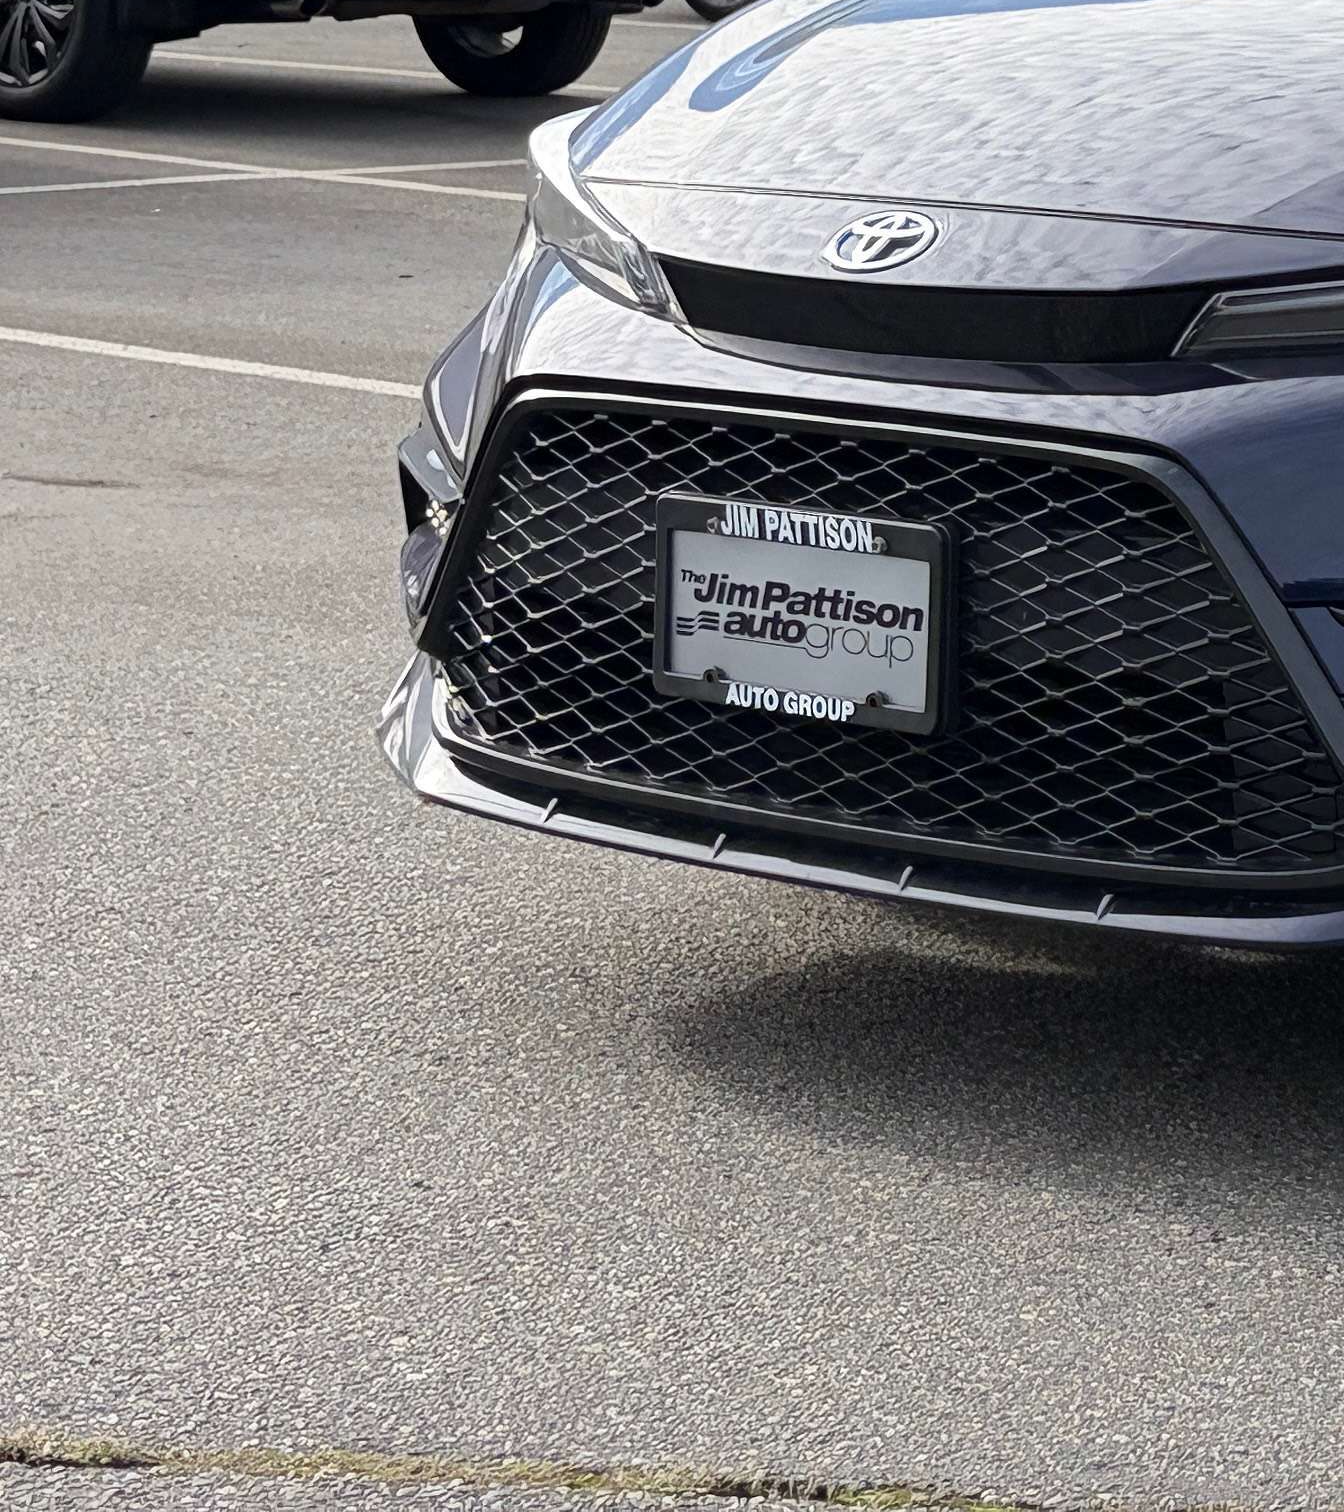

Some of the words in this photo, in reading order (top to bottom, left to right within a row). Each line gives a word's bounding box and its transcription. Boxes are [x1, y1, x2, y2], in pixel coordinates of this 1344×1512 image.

[720, 503, 760, 538] JIM
[764, 508, 873, 553] PATTISON
[680, 568, 706, 585] The
[724, 683, 778, 712] AUTO
[783, 690, 856, 722] GROUP
